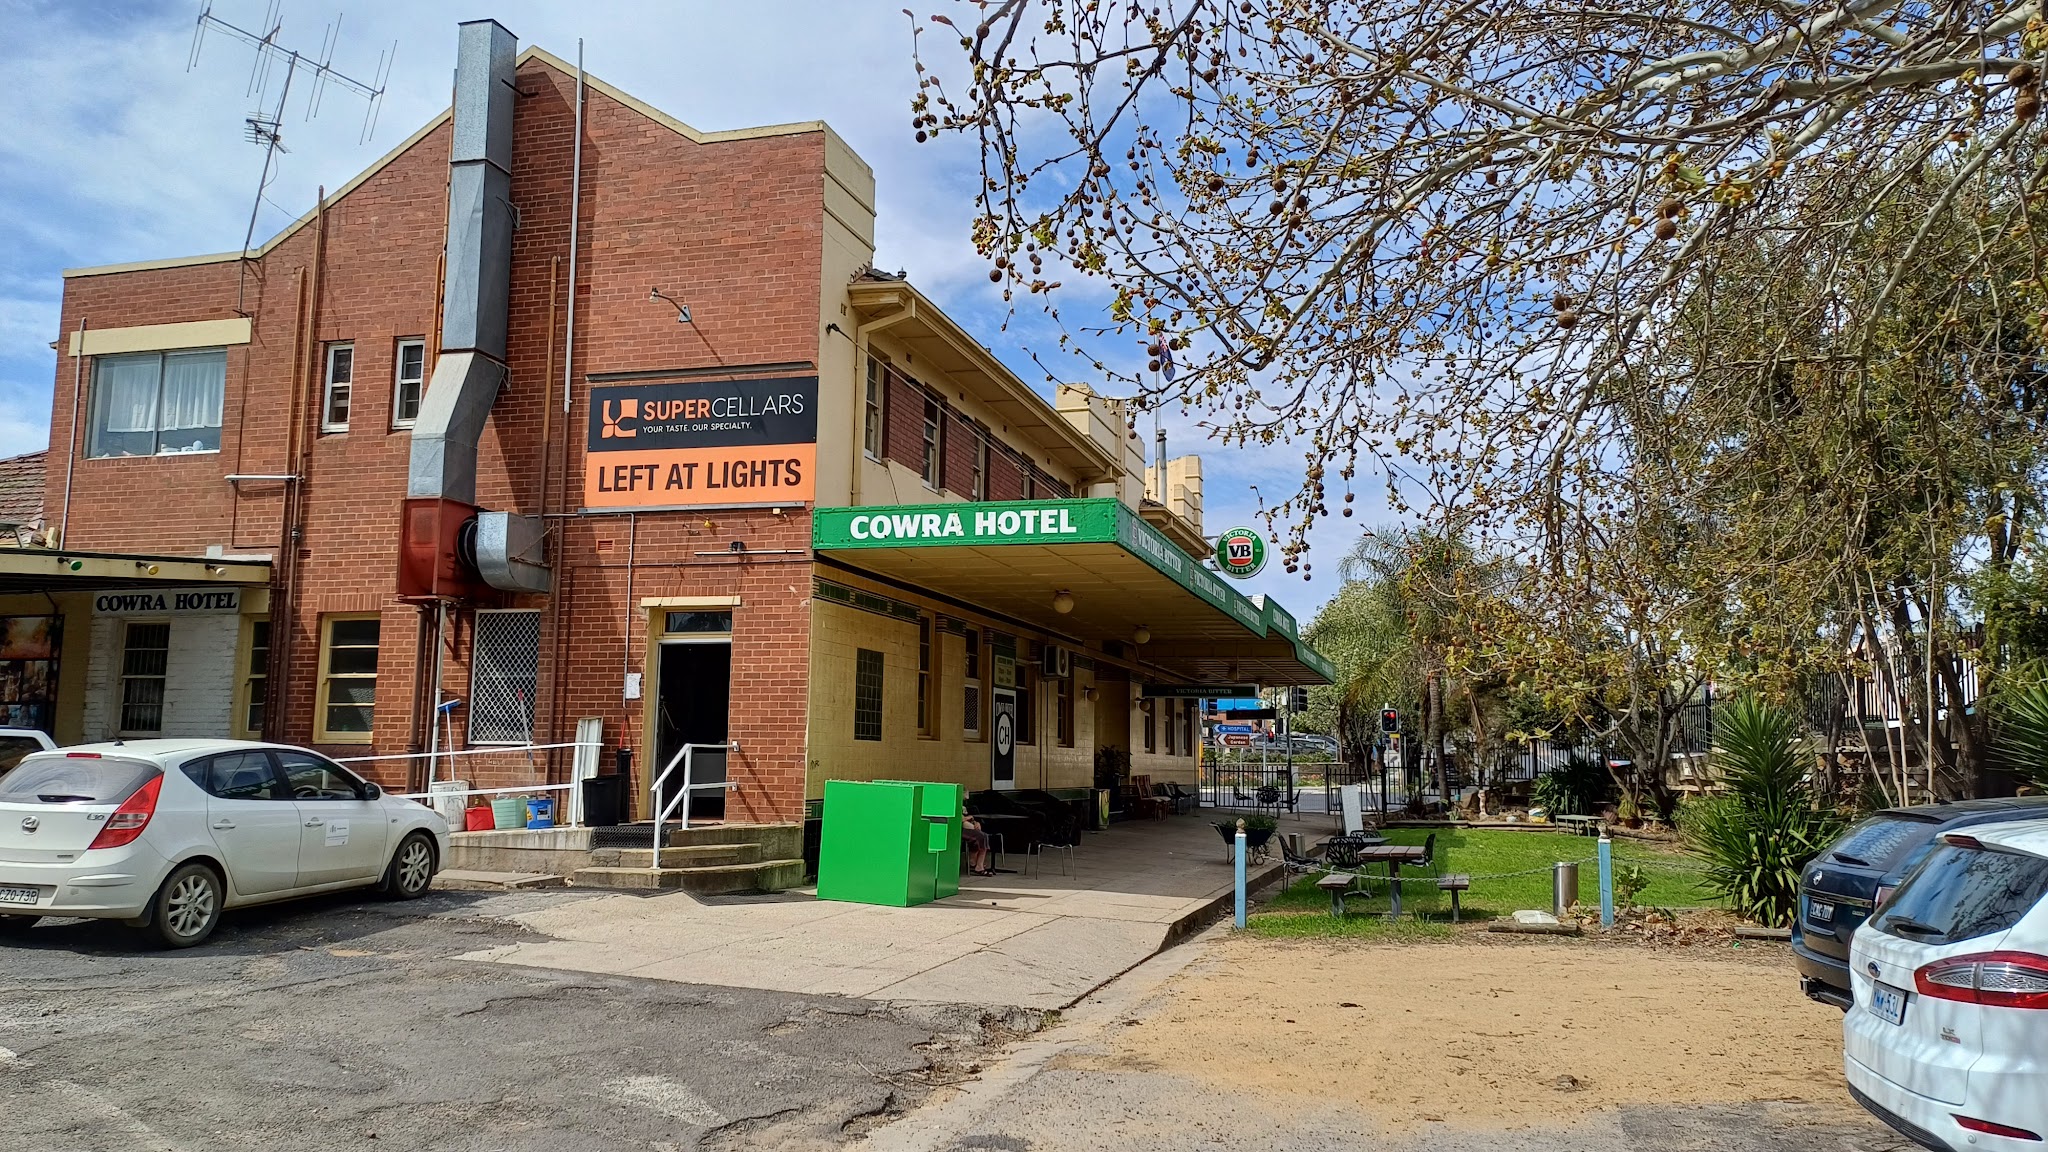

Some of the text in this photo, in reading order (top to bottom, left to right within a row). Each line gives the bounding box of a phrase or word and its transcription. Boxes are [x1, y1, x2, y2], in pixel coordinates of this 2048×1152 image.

[643, 393, 804, 421] SUPERCELLARS
[643, 421, 752, 434] YOUR TASTE. OUR SPECIALTY.
[598, 458, 801, 493] LEFT AT LIGHTS
[850, 508, 1078, 540] COWRA HOTEL
[1222, 529, 1257, 542] VICTORIA
[1228, 544, 1252, 558] VB
[1226, 562, 1257, 573] BITTER
[96, 592, 238, 612] COWRA HOTEL
[998, 724, 1010, 746] CH
